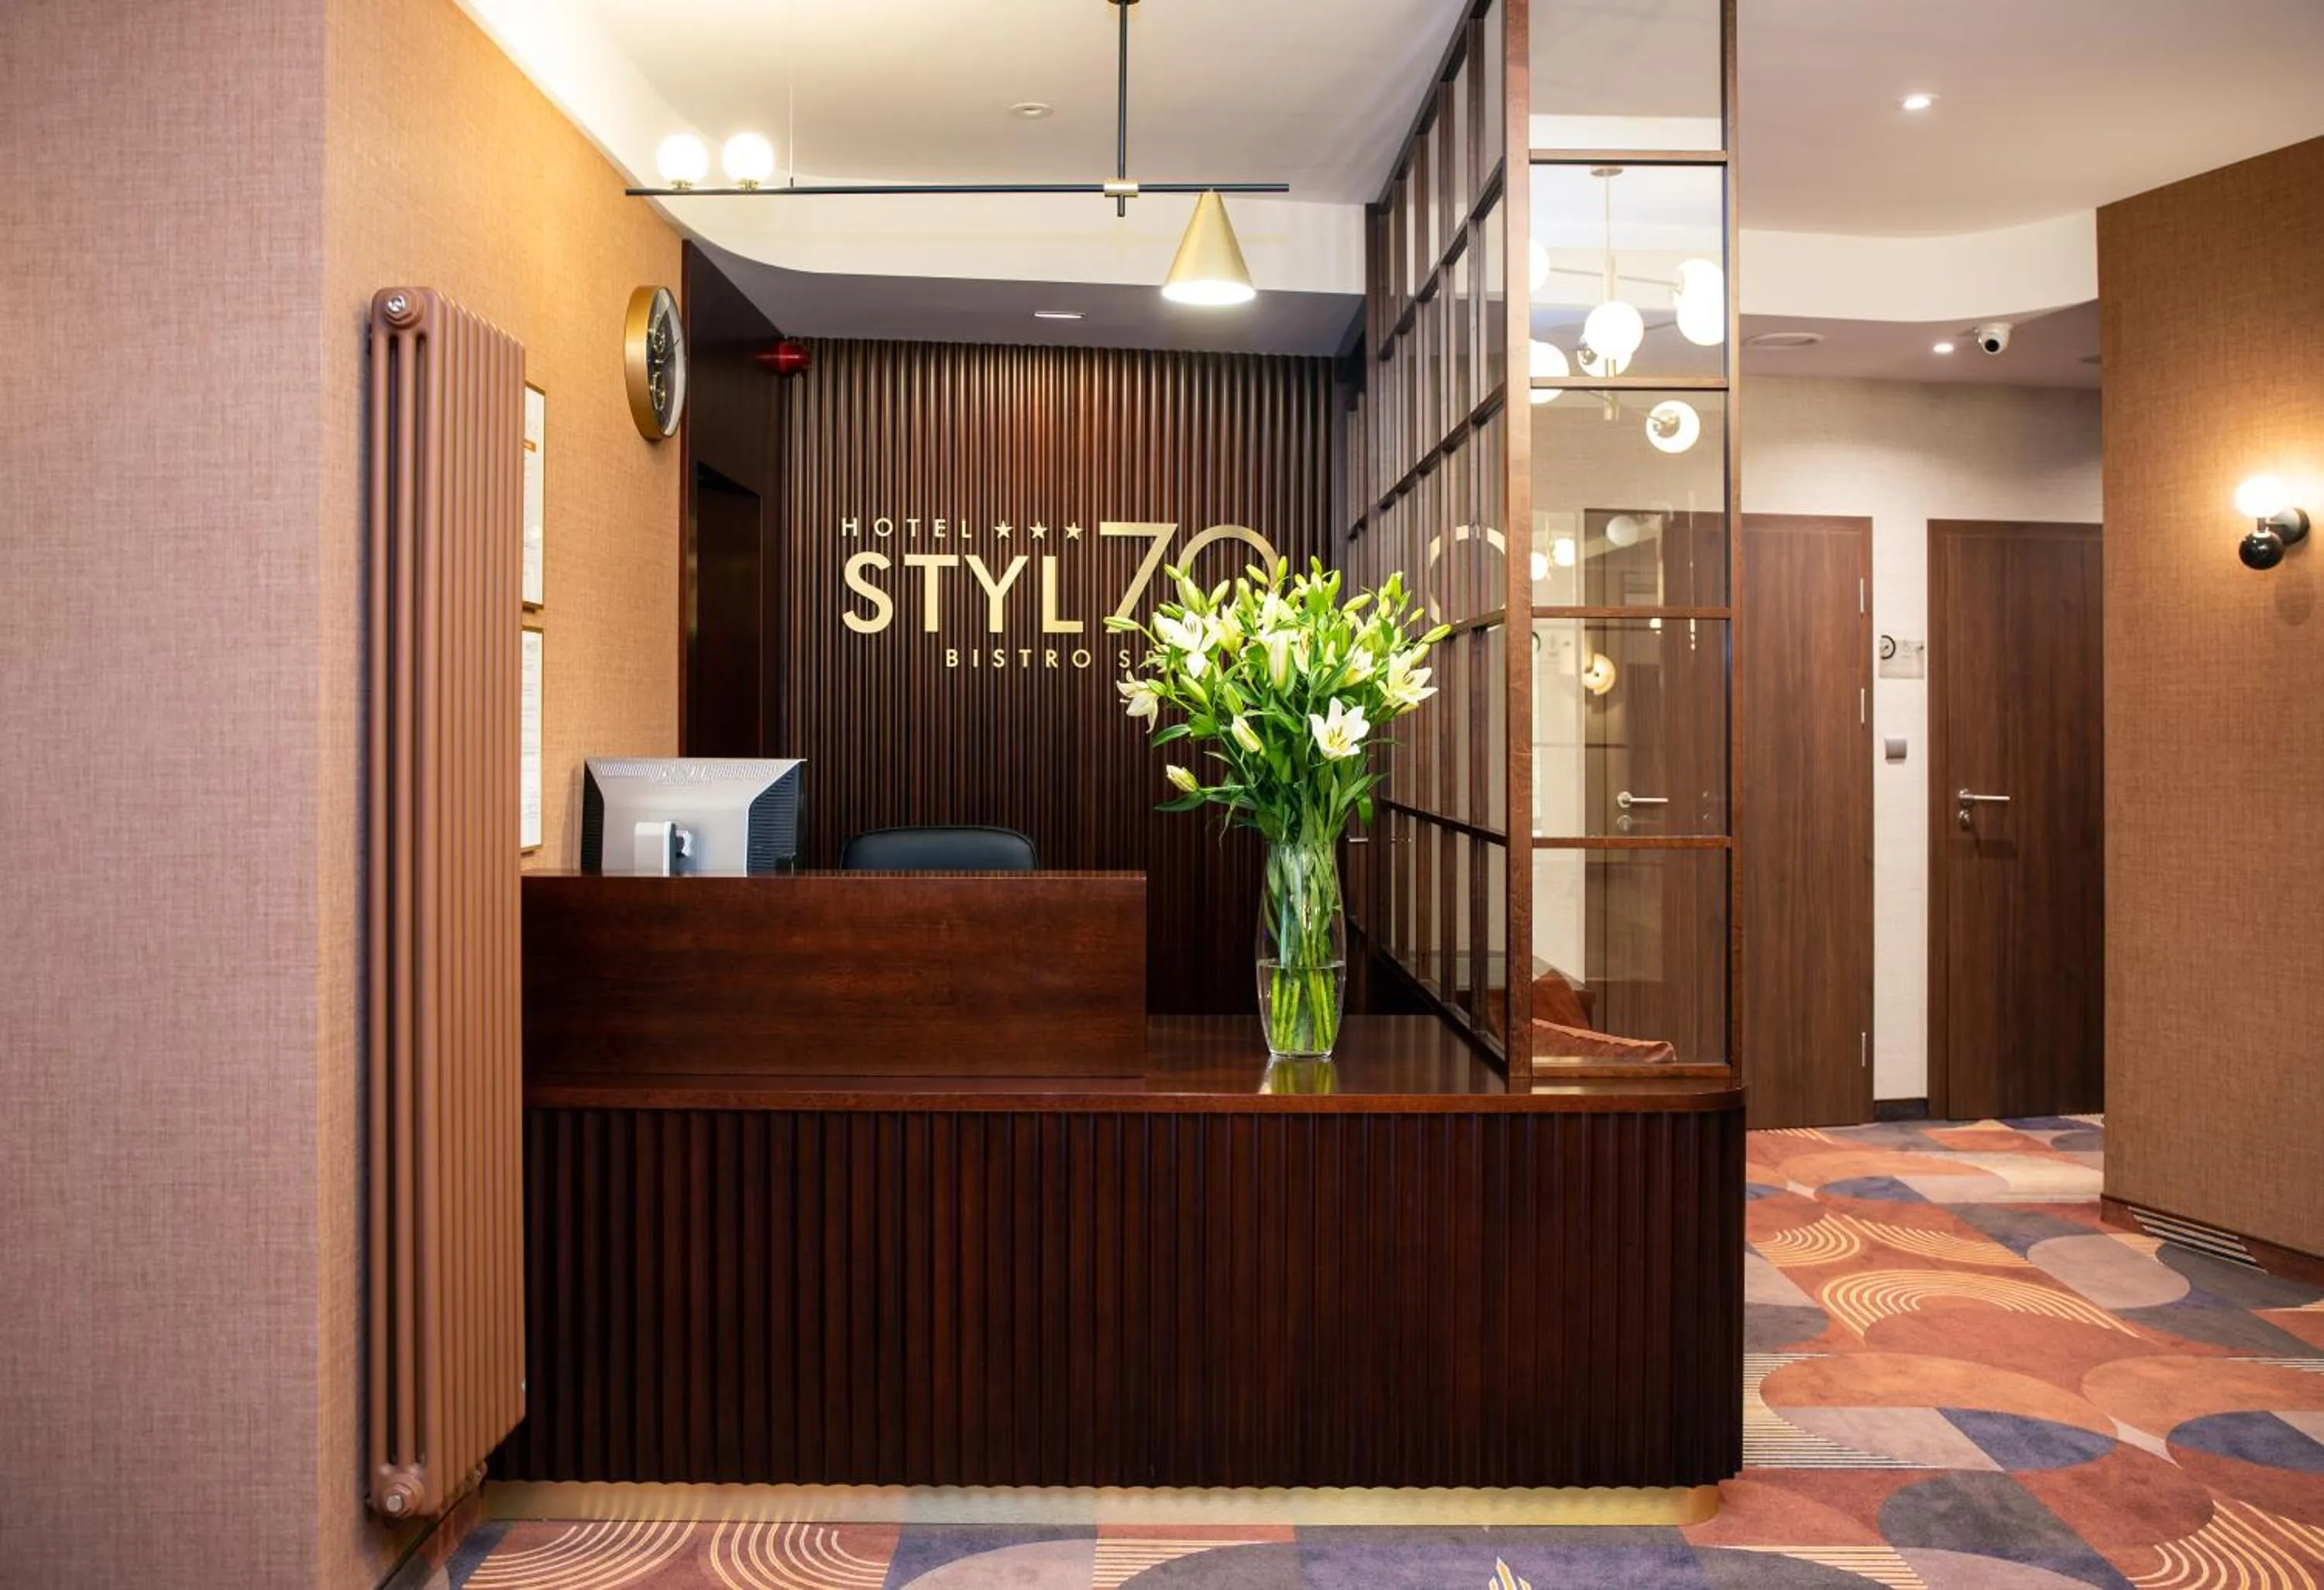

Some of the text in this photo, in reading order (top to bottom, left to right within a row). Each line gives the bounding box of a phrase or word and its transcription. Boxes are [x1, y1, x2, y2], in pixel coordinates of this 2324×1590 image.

[841, 517, 972, 539] HOTEL
[842, 551, 1084, 633] STYL
[945, 649, 1092, 668] BISTRO
